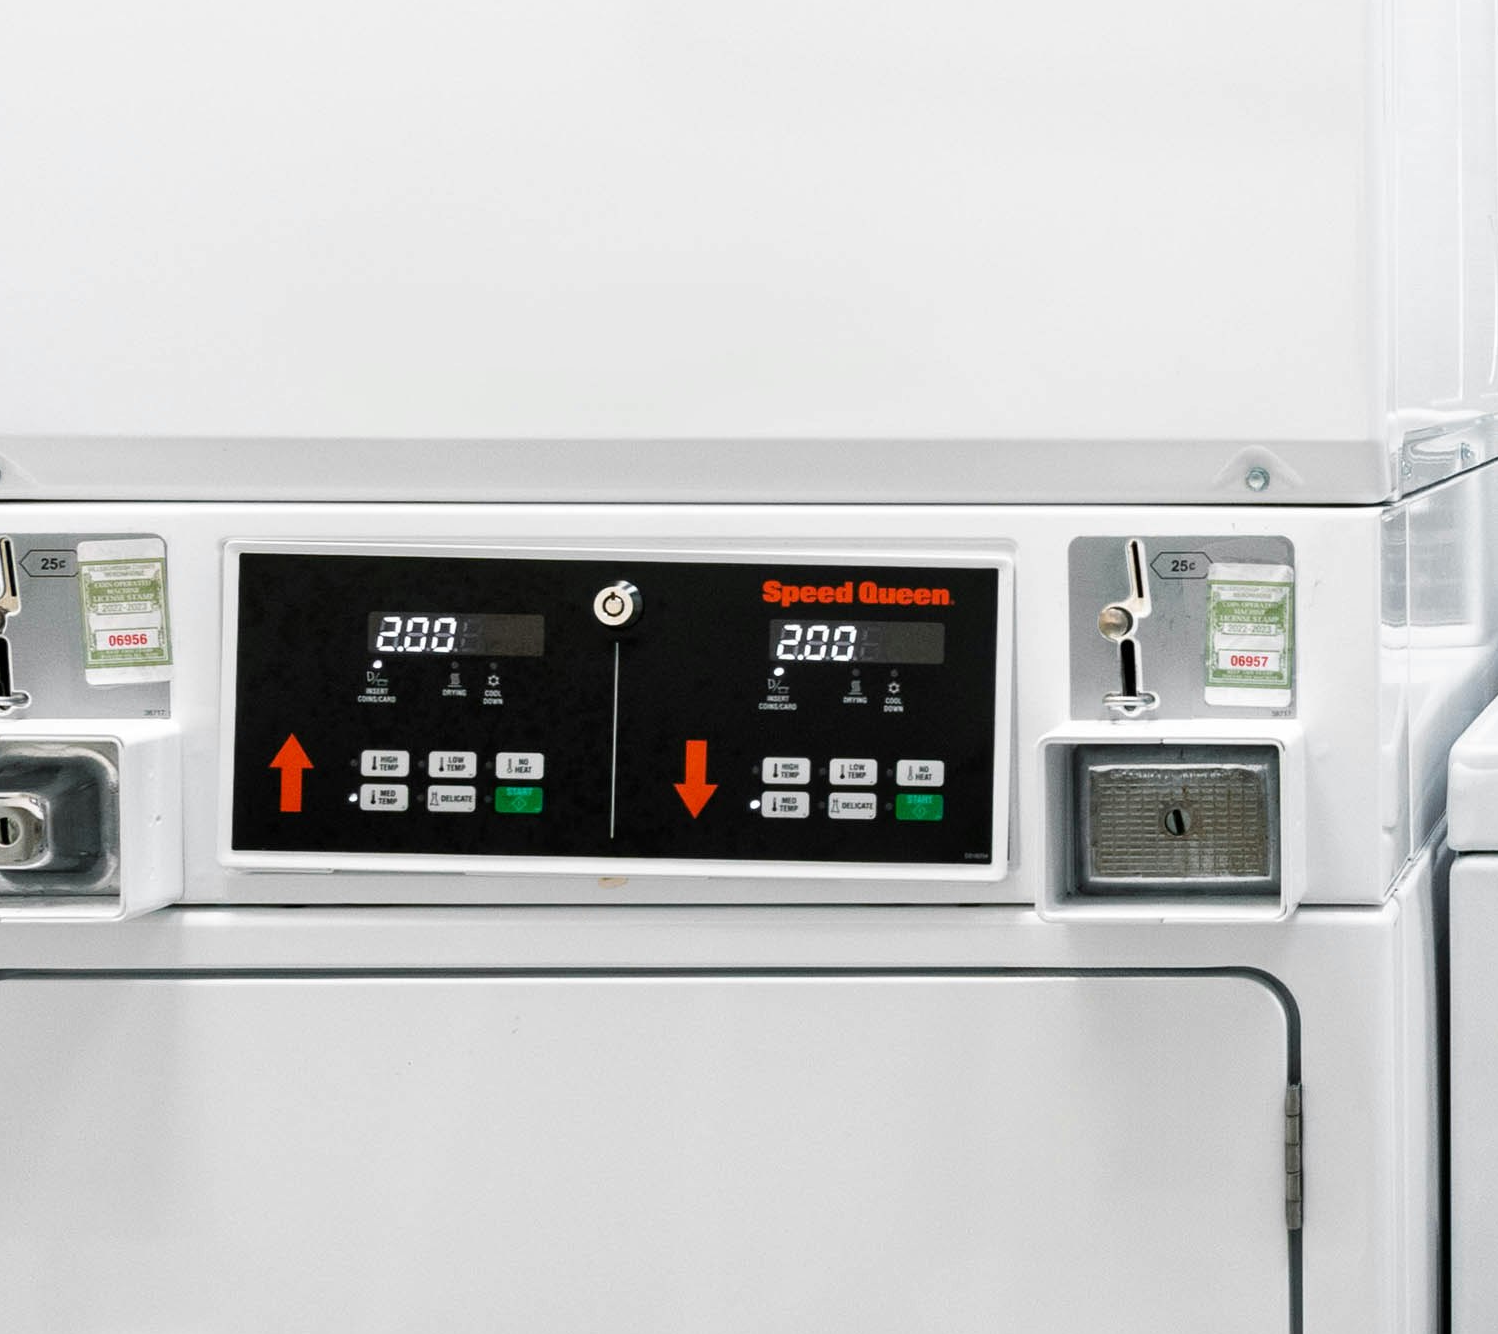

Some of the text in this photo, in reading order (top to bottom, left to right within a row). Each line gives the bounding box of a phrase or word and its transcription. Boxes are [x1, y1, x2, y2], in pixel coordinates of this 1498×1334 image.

[763, 580, 950, 606] Speed Queen
[109, 634, 147, 646] 06956
[376, 617, 457, 652] 2.00
[776, 625, 857, 661] 2.00
[1231, 656, 1268, 667] 06957
[907, 795, 932, 803] START
